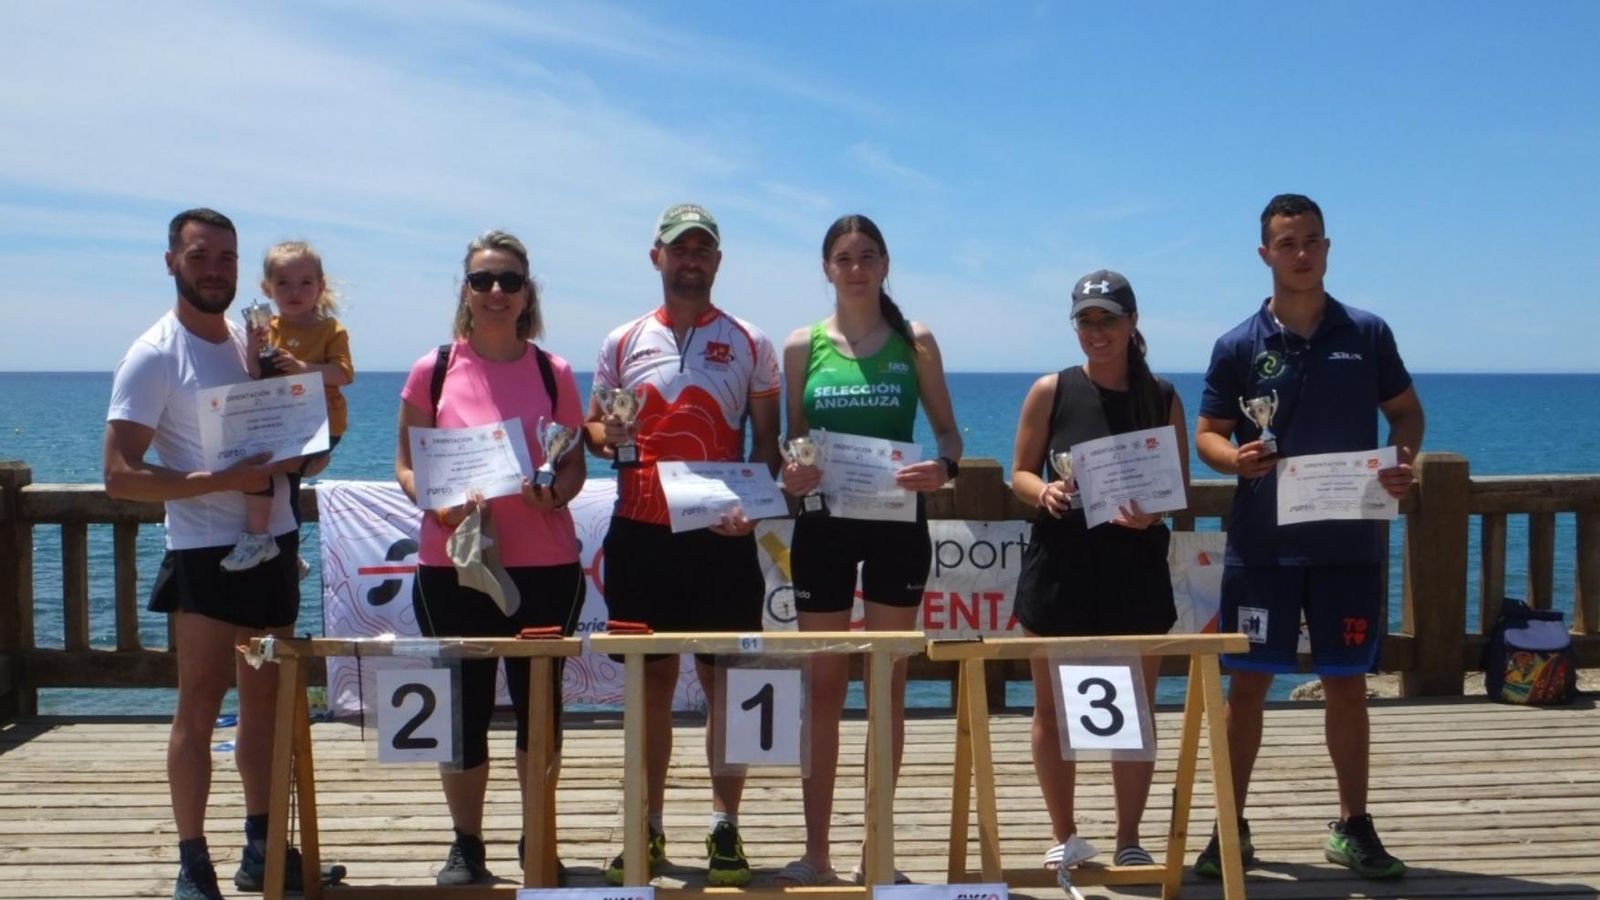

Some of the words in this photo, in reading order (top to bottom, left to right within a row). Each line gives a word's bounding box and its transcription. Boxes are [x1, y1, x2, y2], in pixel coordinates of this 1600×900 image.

[813, 382, 901, 397] SELECCIÓN
[815, 396, 900, 410] ANDALUZA
[391, 683, 438, 749] 2
[740, 682, 774, 751] 1
[1077, 677, 1125, 737] 3
